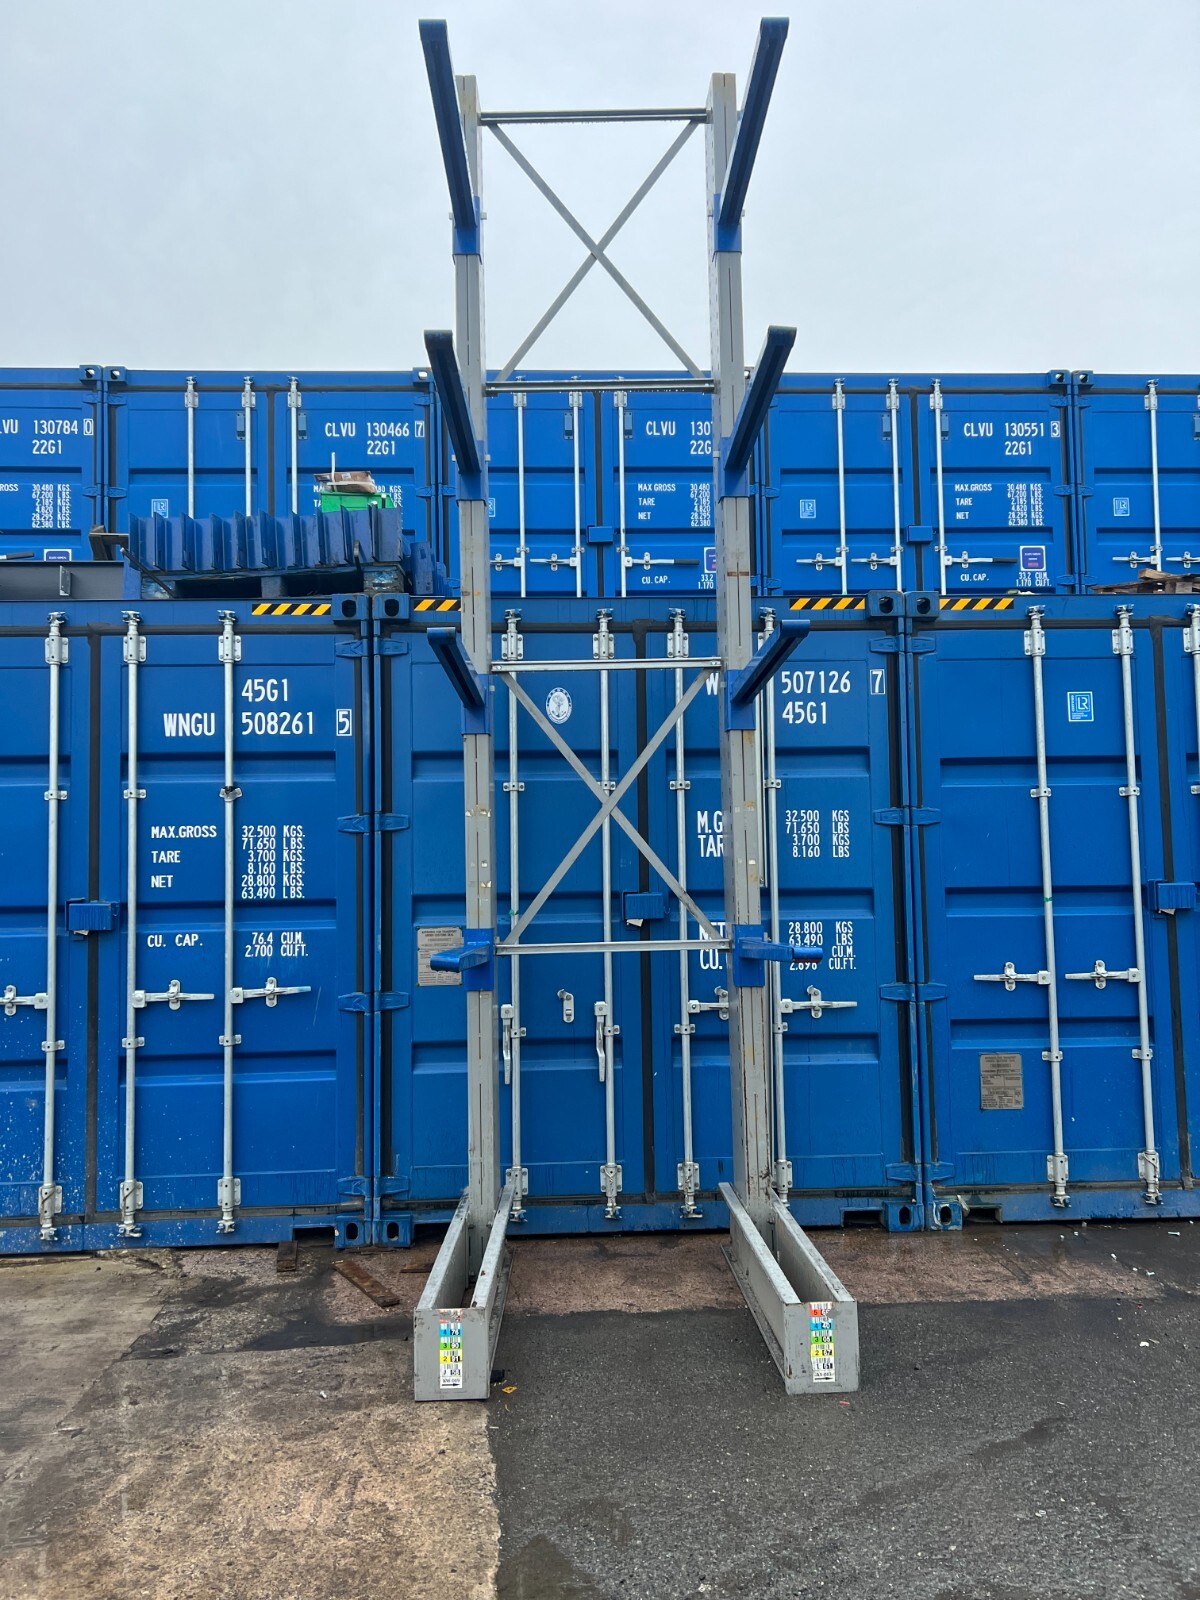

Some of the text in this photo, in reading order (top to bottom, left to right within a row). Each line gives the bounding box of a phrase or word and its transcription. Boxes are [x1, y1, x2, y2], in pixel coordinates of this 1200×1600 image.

[0, 419, 18, 434] VU
[34, 420, 78, 434] 130784
[325, 422, 424, 437] CLVU 130466 7
[646, 421, 712, 436] CLVU 130
[964, 422, 1060, 437] CLVU 130551 3
[32, 440, 62, 454] 22G1
[367, 440, 395, 455] 22G1
[1005, 441, 1032, 455] 22G1
[782, 671, 851, 694] 507126
[871, 670, 884, 694] 7
[242, 678, 288, 702] 45G1
[782, 702, 827, 724] 45G1
[164, 710, 351, 737] WNGU 508261 5
[832, 810, 849, 822] KGS
[151, 825, 305, 838] MAX.GROSS 32.500 KGS.
[832, 822, 849, 834] LBS
[283, 838, 305, 850] LBS.
[698, 834, 724, 858] TAR
[832, 834, 850, 846] KGS
[152, 850, 181, 863] TARE
[283, 850, 305, 862] KGS.
[833, 846, 850, 858] LBS
[283, 862, 305, 874] LBS.
[151, 875, 173, 888] NET
[283, 874, 305, 886] KGS.
[283, 887, 305, 899] LBS.
[789, 922, 823, 934] 28.800
[836, 921, 853, 933] KGS
[147, 935, 166, 947] CU.
[175, 934, 203, 947] CAP.
[252, 932, 273, 944] 76.4
[789, 934, 853, 946] 63.490 LBS
[245, 944, 308, 958] 2.700 CU.FT.
[832, 945, 856, 958] CU.M.
[828, 958, 857, 970] CU.FT.
